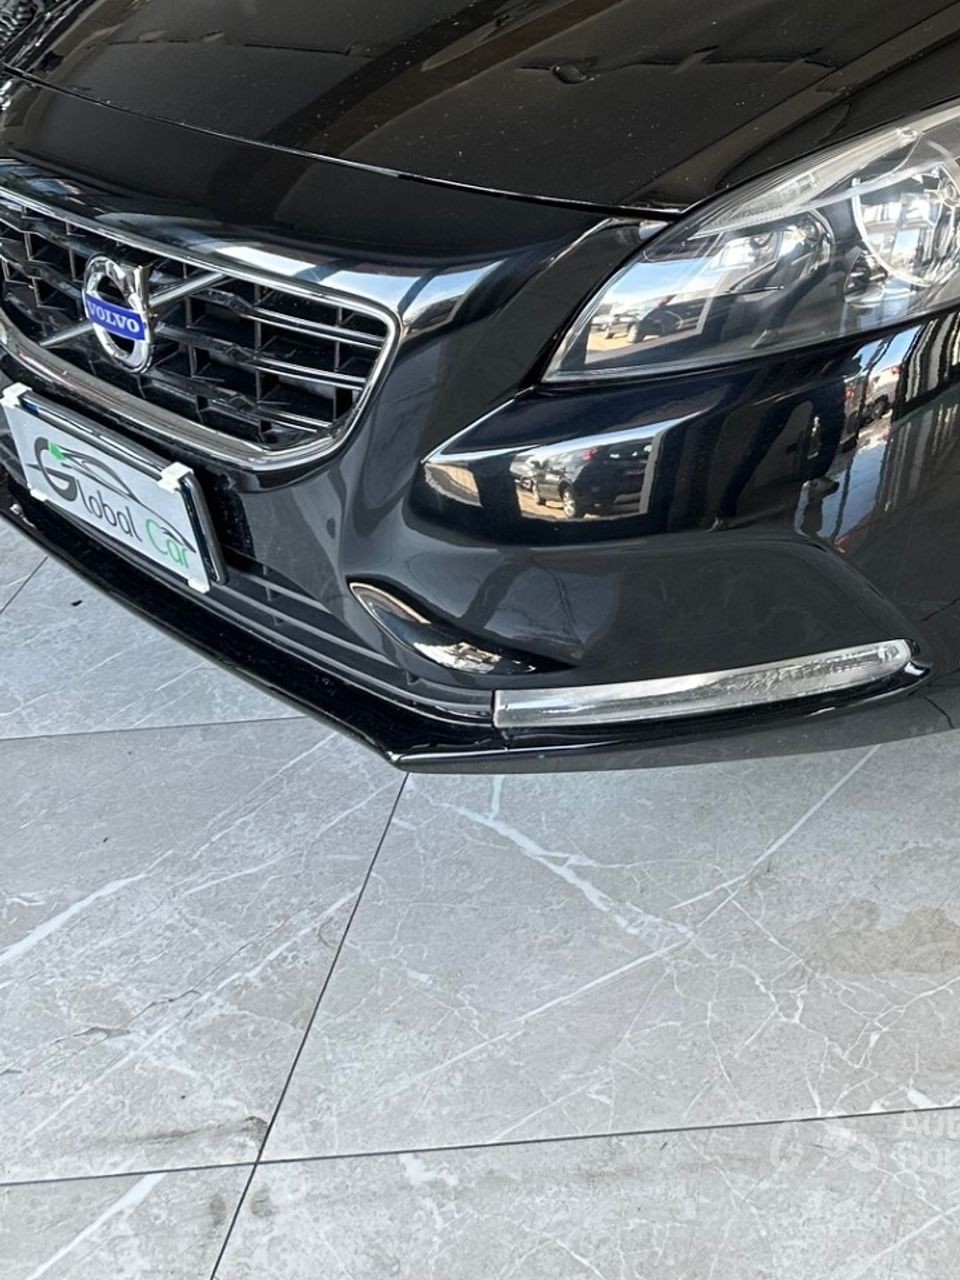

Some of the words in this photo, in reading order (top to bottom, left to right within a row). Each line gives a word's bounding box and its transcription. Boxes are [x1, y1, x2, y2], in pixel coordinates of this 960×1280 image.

[87, 299, 140, 333] VOLVO
[34, 436, 143, 542] Global
[145, 518, 189, 568] Car
